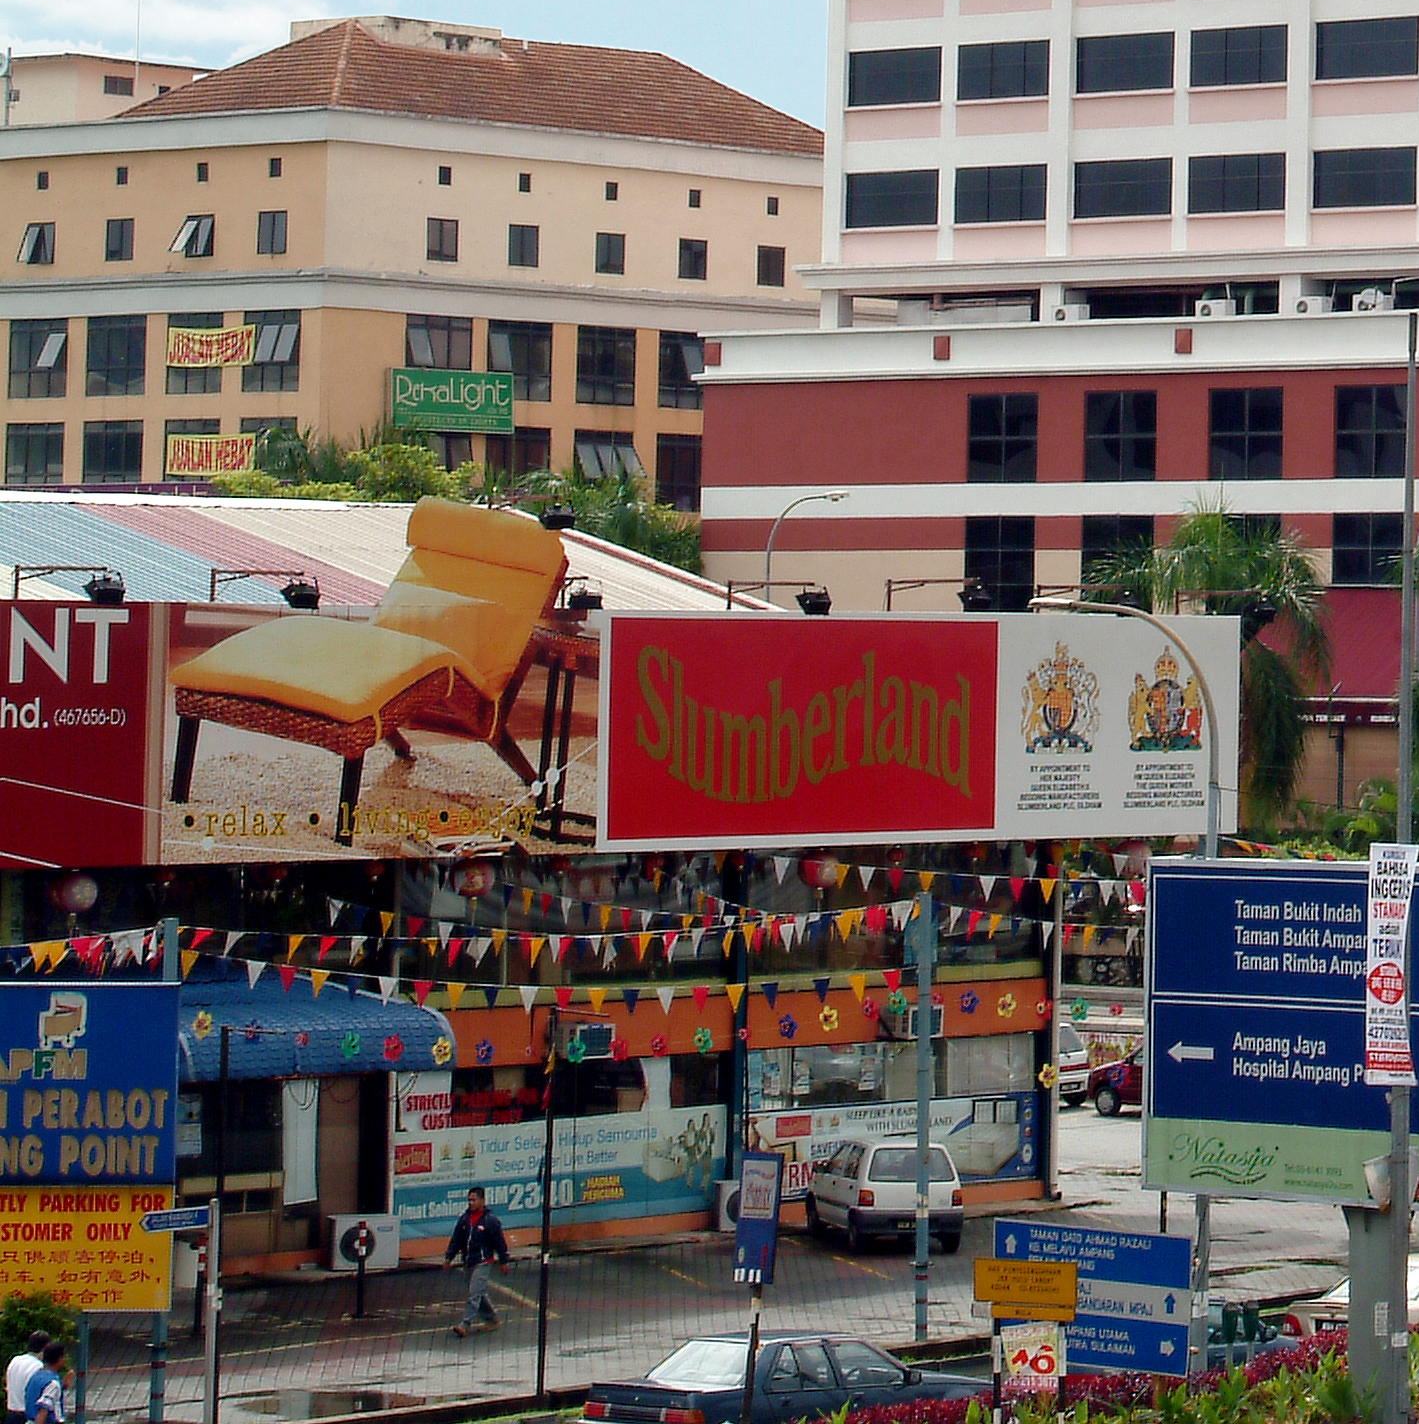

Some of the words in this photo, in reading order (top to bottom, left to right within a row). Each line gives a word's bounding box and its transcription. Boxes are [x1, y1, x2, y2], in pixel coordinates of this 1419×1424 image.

[636, 645, 973, 804] Slumberland
[204, 805, 288, 838] relax
[340, 802, 432, 842] living
[457, 806, 539, 839] enjoy
[1234, 899, 1280, 920] Taman
[1283, 901, 1319, 921] Bukit
[1323, 902, 1362, 923] Indah
[1234, 925, 1279, 947] Taman
[1282, 927, 1319, 948] Bukit
[1234, 951, 1279, 972] Taman
[1282, 953, 1327, 974] Rimba
[1232, 1031, 1291, 1057] Ampang
[1293, 1035, 1326, 1060] Jaya
[1232, 1057, 1290, 1083] Hospital
[1292, 1060, 1350, 1087] Ampang
[1353, 1065, 1366, 1083] P
[23, 1088, 168, 1129] PERABOT
[59, 1134, 159, 1176] POINT
[478, 1138, 510, 1155] Tidur
[494, 1157, 525, 1174] Sleep
[586, 1149, 619, 1165] Better
[39, 1193, 121, 1213] PARKING
[131, 1193, 166, 1213] FOR
[1, 1223, 73, 1242] STOMER
[87, 1223, 132, 1242] ONLY
